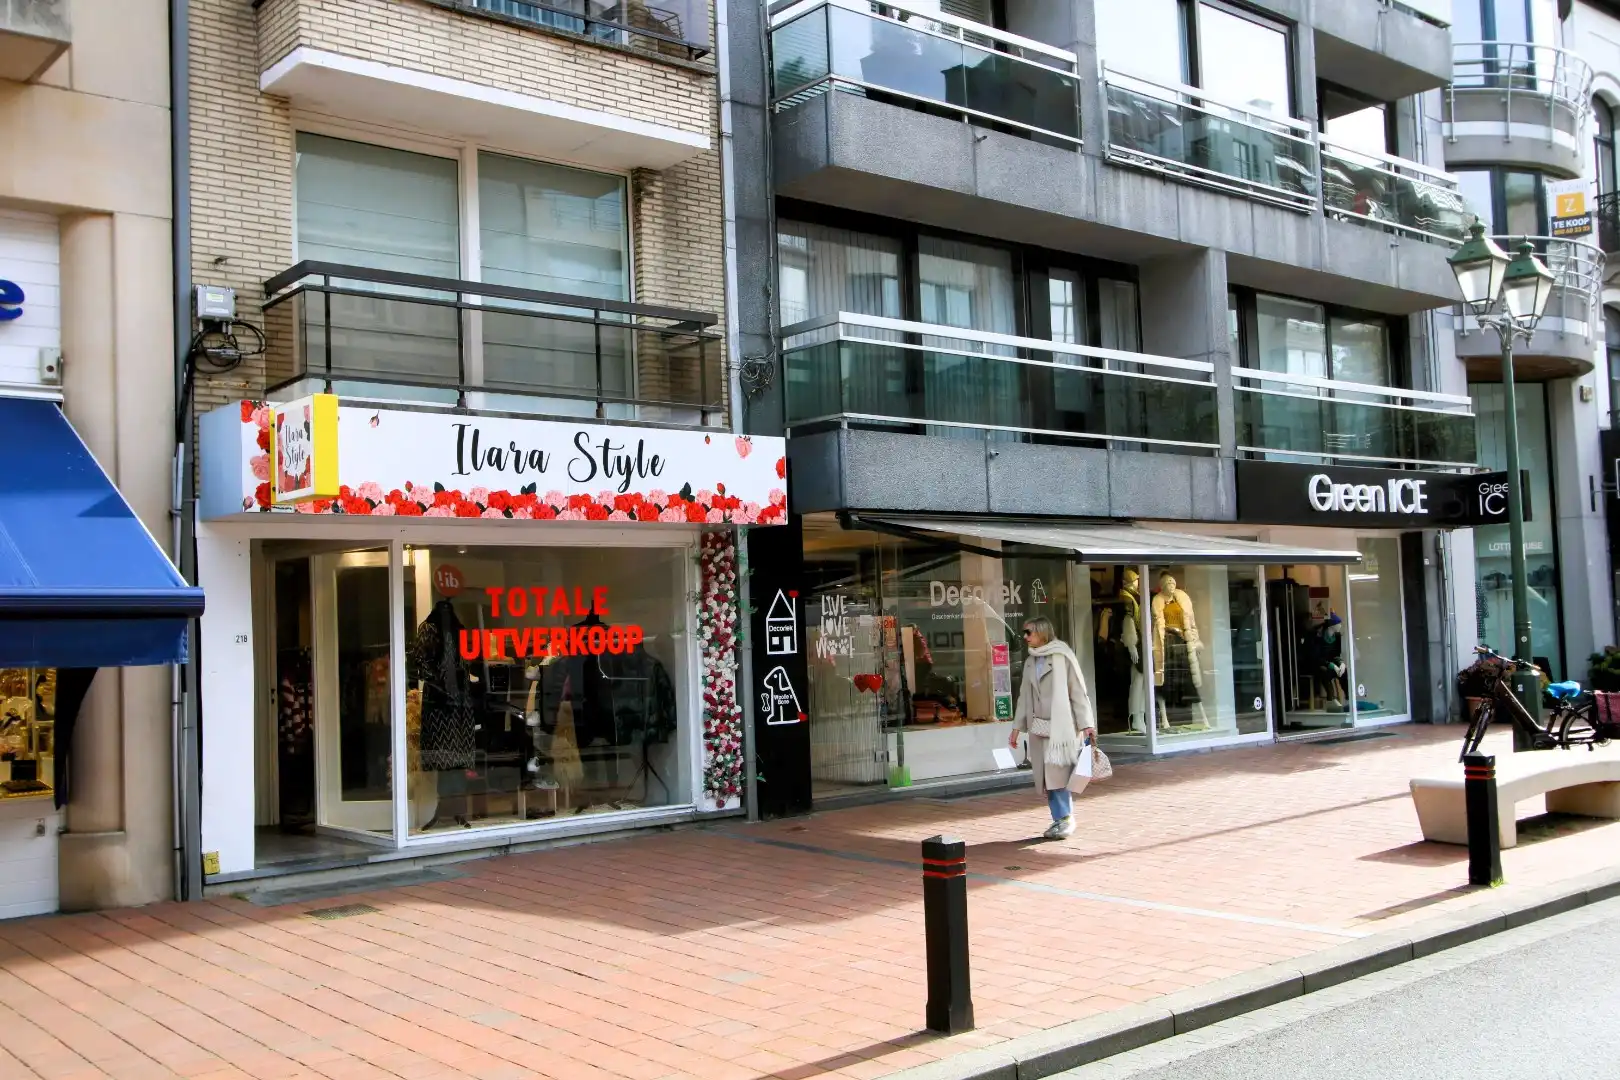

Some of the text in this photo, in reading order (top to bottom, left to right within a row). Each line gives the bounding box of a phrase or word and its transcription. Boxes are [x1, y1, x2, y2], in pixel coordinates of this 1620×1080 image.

[1564, 198, 1577, 212] Z
[1553, 217, 1590, 229] TE KOOP
[284, 425, 303, 444] Ilara
[284, 444, 305, 469] Style
[451, 423, 666, 493] Ilara Style
[1308, 474, 1428, 514] Green ICE
[1478, 482, 1508, 494] Gree
[1478, 492, 1506, 516] IC
[485, 585, 611, 617] TOTALE
[821, 594, 849, 616] LIVE
[768, 624, 794, 632] Decoriek
[820, 615, 850, 637] LOVE
[235, 634, 248, 643] 218
[459, 624, 645, 661] UITVERKOOP
